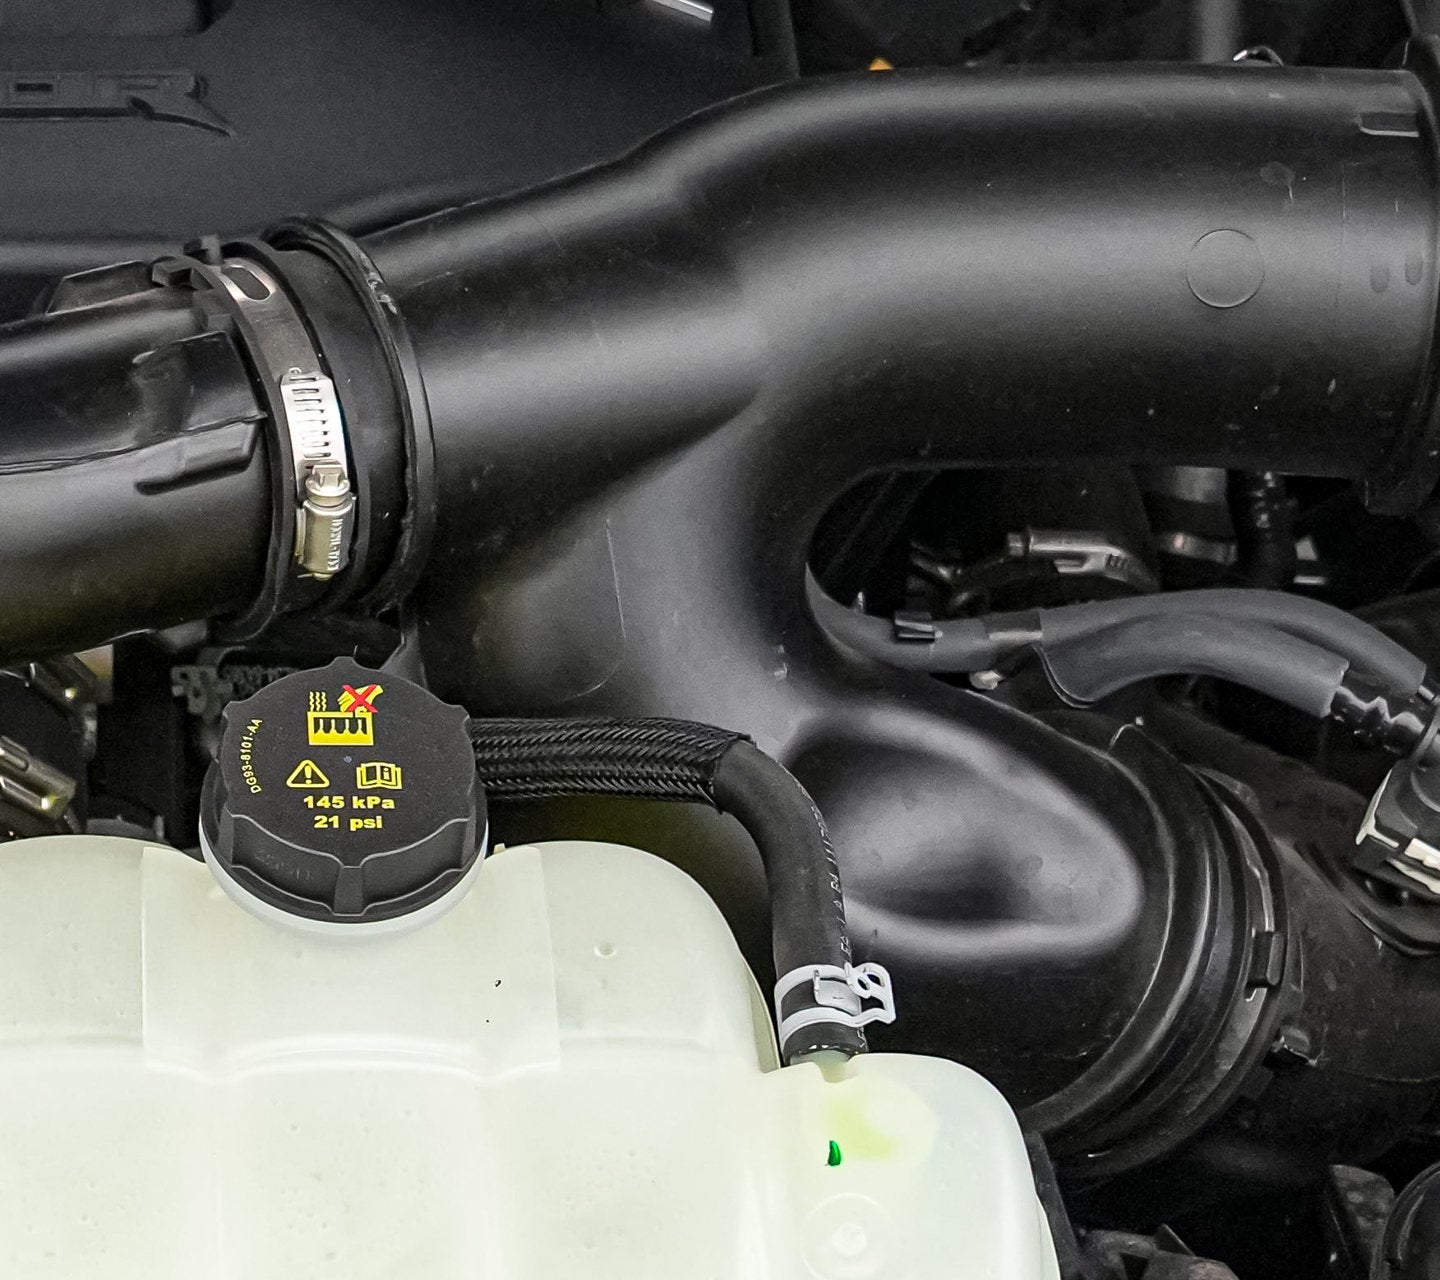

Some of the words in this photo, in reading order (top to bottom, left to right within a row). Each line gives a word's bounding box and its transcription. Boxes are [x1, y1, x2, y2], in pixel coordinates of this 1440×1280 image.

[240, 717, 265, 794] DG93-8101-AA
[303, 795, 345, 810] 145
[352, 794, 396, 810] kPa
[313, 815, 340, 829] 21
[350, 815, 384, 832] psi
